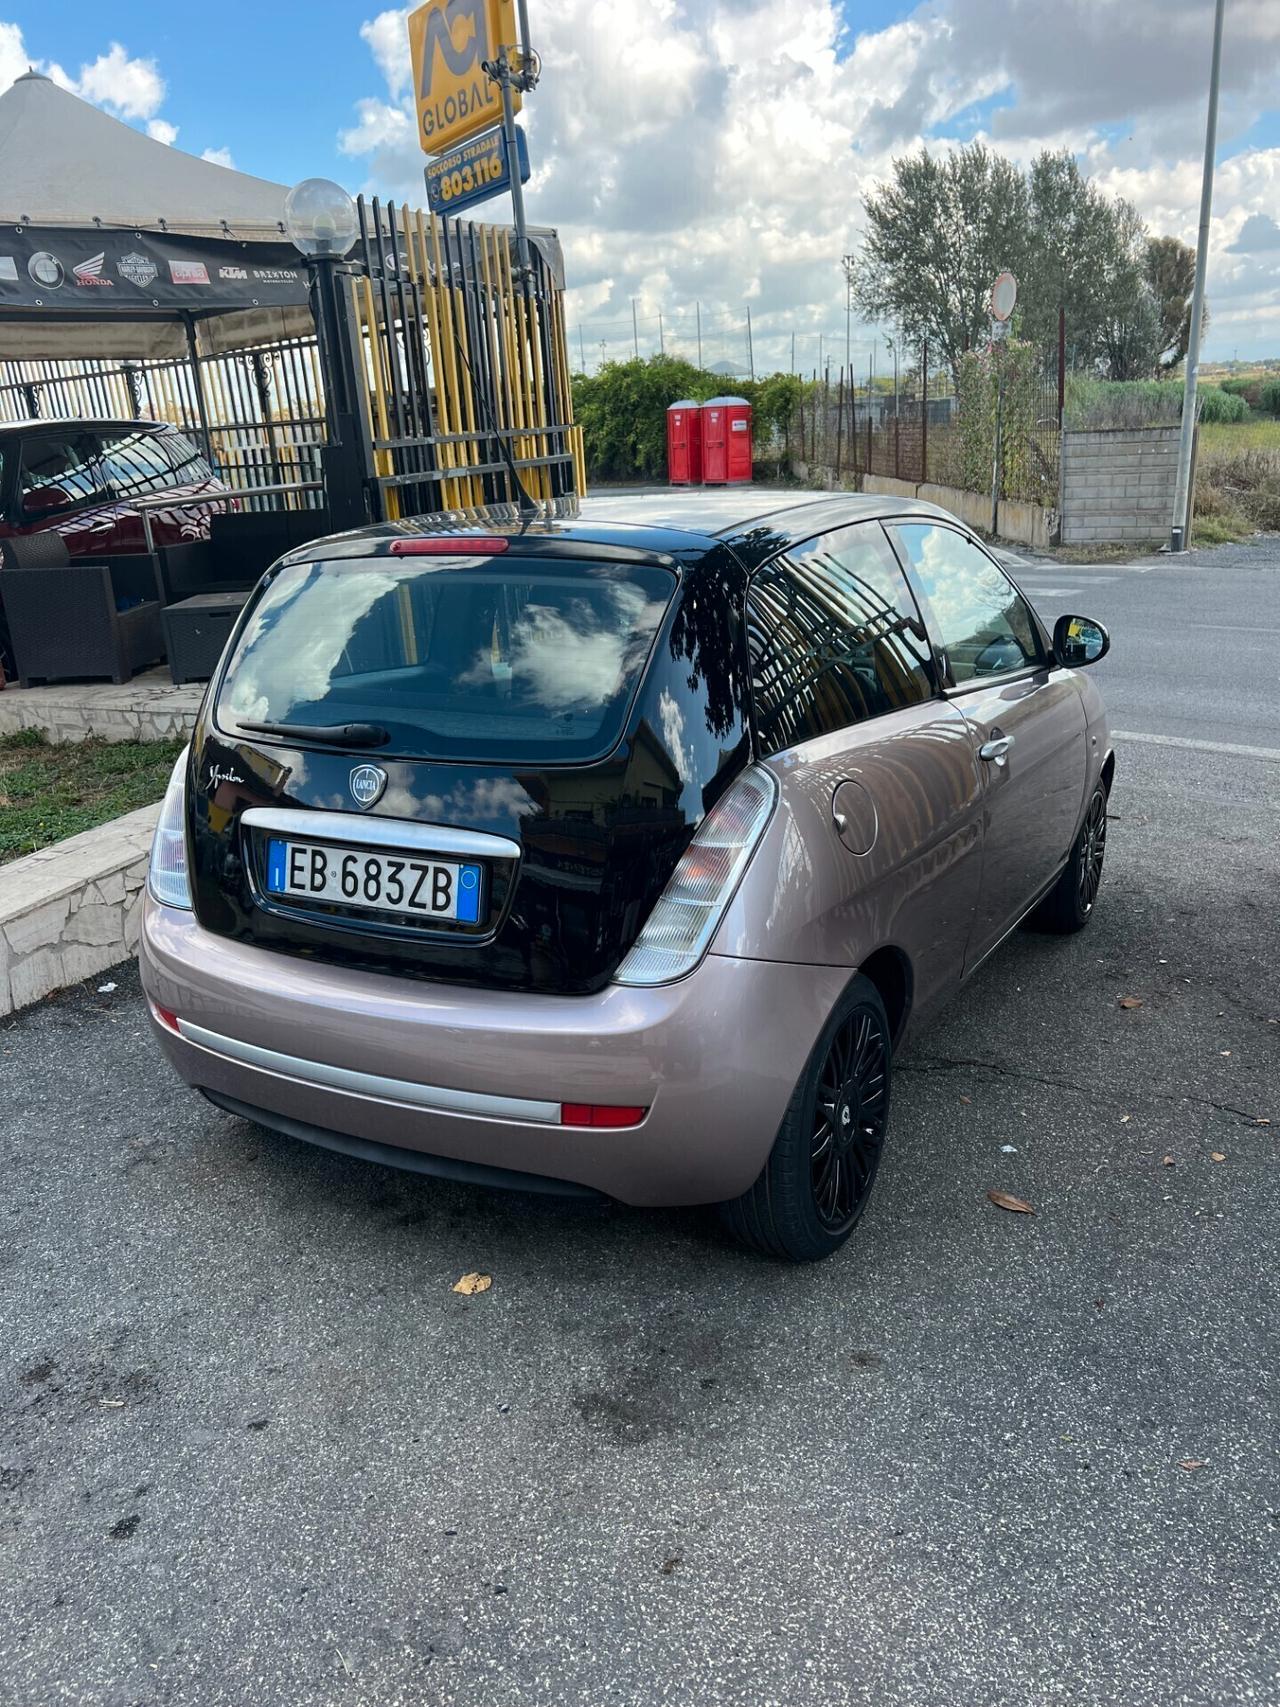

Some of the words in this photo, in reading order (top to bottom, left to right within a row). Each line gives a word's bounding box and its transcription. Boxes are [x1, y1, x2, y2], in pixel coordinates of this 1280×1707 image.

[423, 79, 494, 136] GLOBAL
[427, 153, 462, 179] SOCCORSO
[463, 136, 499, 162] STRADALE
[440, 155, 503, 201] 803.116
[76, 279, 114, 287] HONDA
[219, 266, 248, 279] KTM
[252, 270, 298, 279] BRIXTON
[205, 764, 245, 790] Ypsilon
[355, 778, 376, 791] LANCIA
[289, 847, 328, 893] EB
[341, 854, 453, 912] 683ZB
